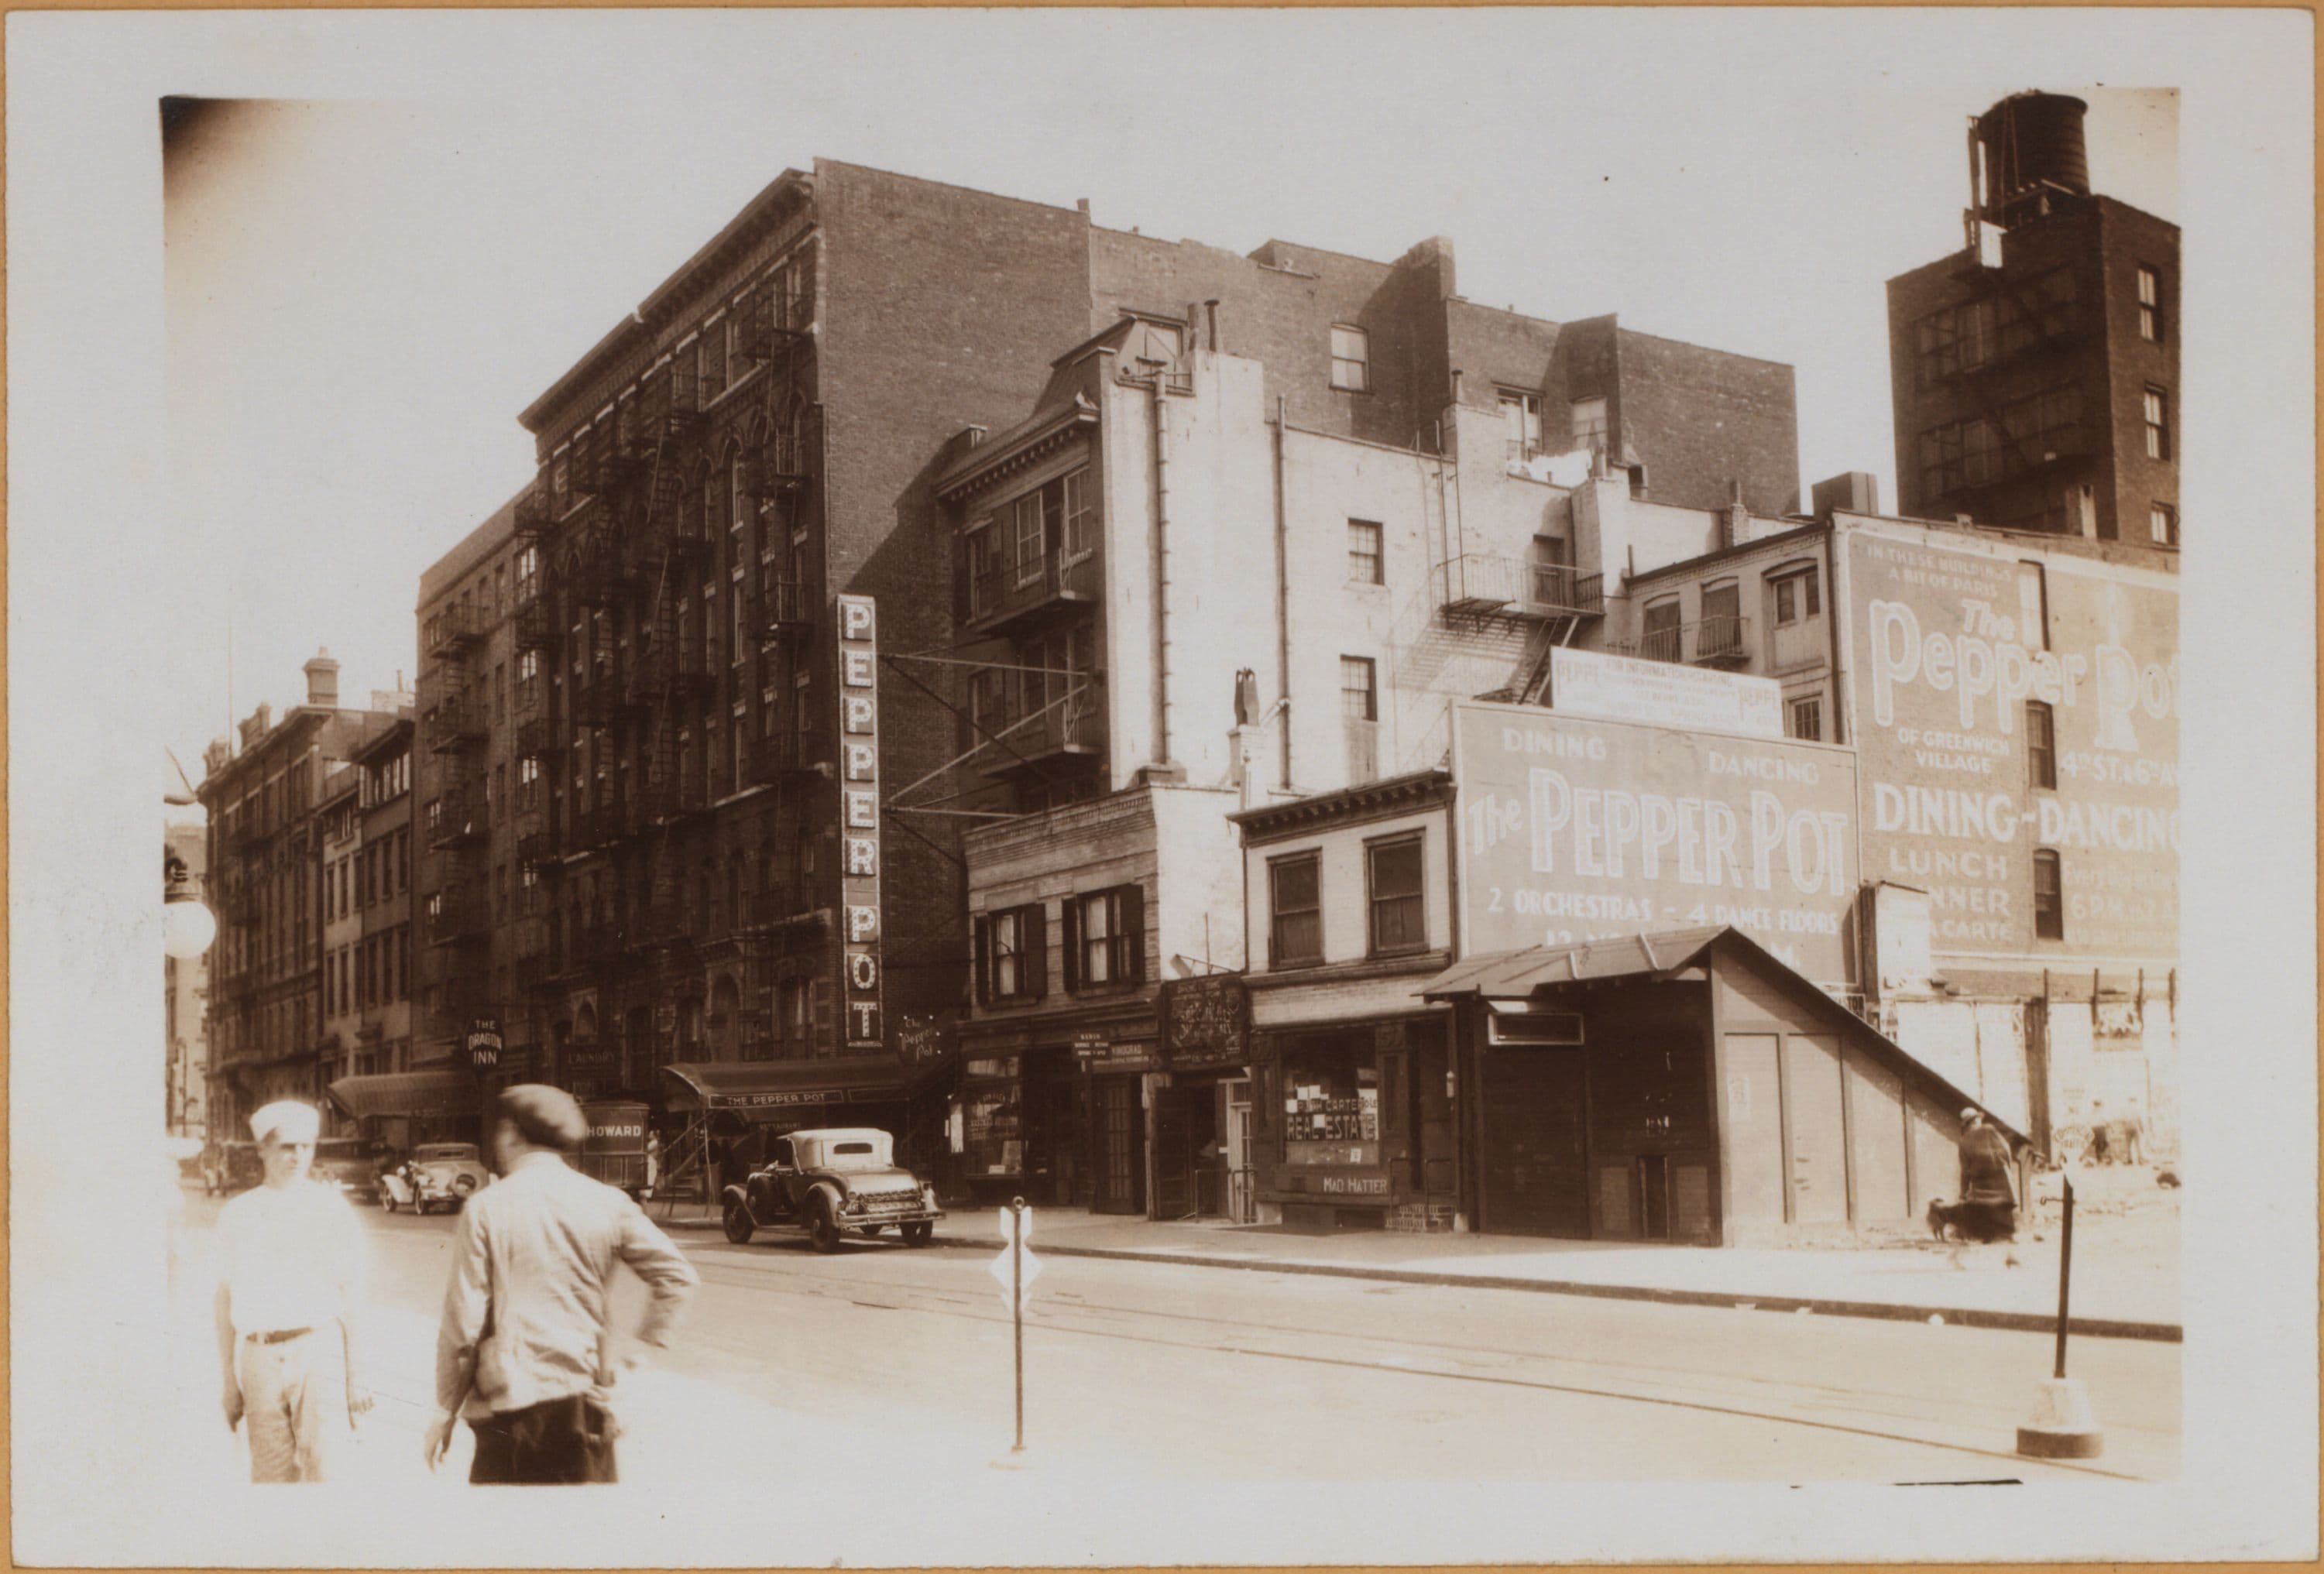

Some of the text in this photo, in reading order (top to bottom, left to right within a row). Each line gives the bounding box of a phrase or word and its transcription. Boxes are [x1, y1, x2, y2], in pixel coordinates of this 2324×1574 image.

[1866, 545, 1883, 560] IN
[1887, 548, 1936, 569] THESE
[1888, 567, 1998, 598] A BIT OF PARIS
[1959, 598, 2016, 640] The
[1868, 598, 2088, 736] Pepper
[1897, 728, 2010, 756] OF GREENWICH
[1503, 729, 1820, 784] DINING DANCING
[1915, 749, 1991, 774] VILLAGE
[845, 603, 879, 1038] PEPPER POT
[1468, 767, 1848, 897] The PEPPER POT
[1890, 848, 2008, 882] LUNCH
[1488, 888, 1504, 913] 2
[1513, 889, 1652, 923] ORCHESTRAS
[1686, 903, 1707, 925] 4
[1714, 906, 1771, 931] DANCE
[1779, 908, 1838, 936] FLOORS
[1928, 886, 2011, 917] NNER
[1941, 919, 2013, 941] CARTE
[475, 1020, 496, 1030] THE
[468, 1032, 503, 1051] DRAGON
[473, 1051, 498, 1065] INN
[726, 1093, 826, 1106] THE PEPPER POT
[1326, 1098, 1364, 1112] CARTER
[1286, 1114, 1375, 1140] REAL ESTATE
[1323, 1177, 1388, 1193] MAD HATTER
